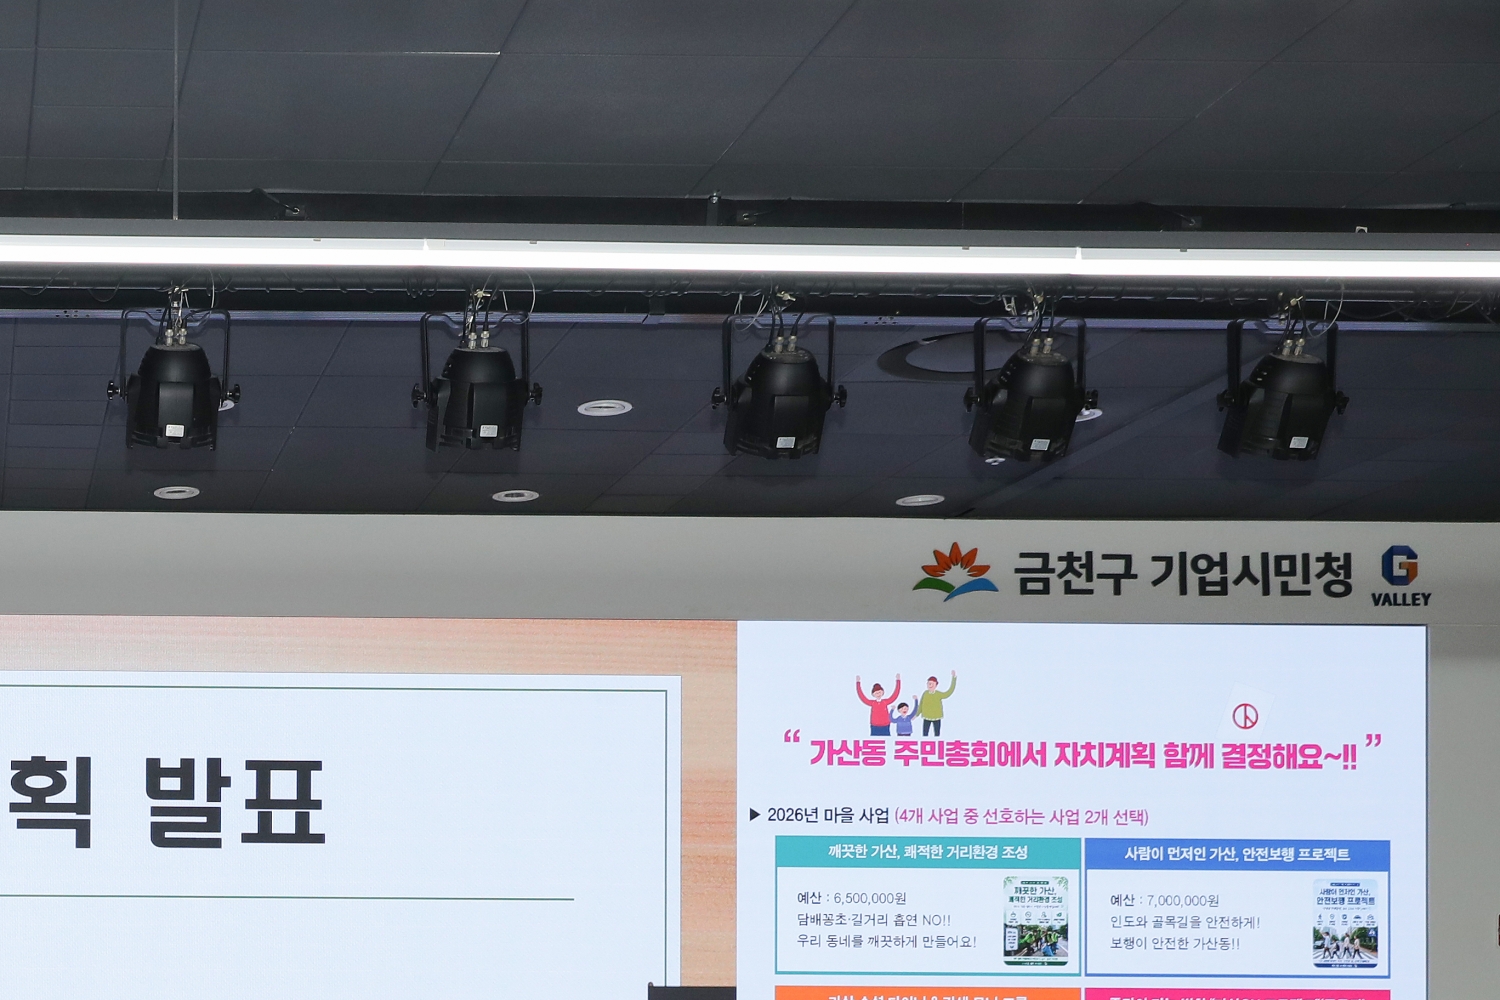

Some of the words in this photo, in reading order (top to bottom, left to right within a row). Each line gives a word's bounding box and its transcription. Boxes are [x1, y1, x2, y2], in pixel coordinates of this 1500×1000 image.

[1013, 552, 1138, 596] 금천구
[1151, 552, 1353, 598] 기업시민청
[1371, 593, 1432, 607] VALLEY
[894, 740, 1047, 767] 주민총회에서
[1054, 741, 1156, 768] 자치계획
[1163, 743, 1215, 769] 함께
[143, 755, 328, 848] 발표
[768, 807, 819, 823] 2026년
[824, 807, 854, 824] 마을
[859, 807, 889, 824] 사업
[895, 807, 923, 824] (4개
[928, 808, 958, 825] 사업
[964, 808, 979, 825] 중
[983, 808, 1045, 825] 선호하는
[1049, 808, 1080, 825] 사업
[1084, 809, 1108, 825] 2개
[1113, 809, 1149, 826] 선택)
[828, 844, 868, 859] 깨끗한
[871, 845, 901, 860] 가산,
[904, 844, 943, 860] 쾌적한
[946, 845, 998, 860] 거리환경
[1001, 845, 1028, 860] 조성
[1124, 847, 1164, 862] 사람이
[1167, 847, 1206, 862] 먼저인
[1209, 847, 1240, 862] 가산,
[1242, 847, 1295, 862] 안전보행
[1297, 847, 1351, 862] 프로젝트
[797, 892, 821, 905] 예산
[834, 892, 906, 906] 6,500,000원
[1110, 894, 1135, 907] 예산
[1147, 894, 1219, 908] 7,000,000원
[893, 913, 918, 927] 흡연
[922, 913, 951, 927] NO!!
[1110, 915, 1148, 929] 인도와
[1152, 915, 1202, 929] 골목길을
[1206, 915, 1261, 929] 안전하게!
[797, 934, 821, 949] 우리
[826, 934, 864, 949] 동네를
[867, 934, 917, 949] 깨끗하게
[922, 934, 977, 949] 만들어요!
[1110, 937, 1147, 951] 보행이
[1152, 937, 1189, 951] 안전한
[1193, 937, 1240, 951] 가산동!!
